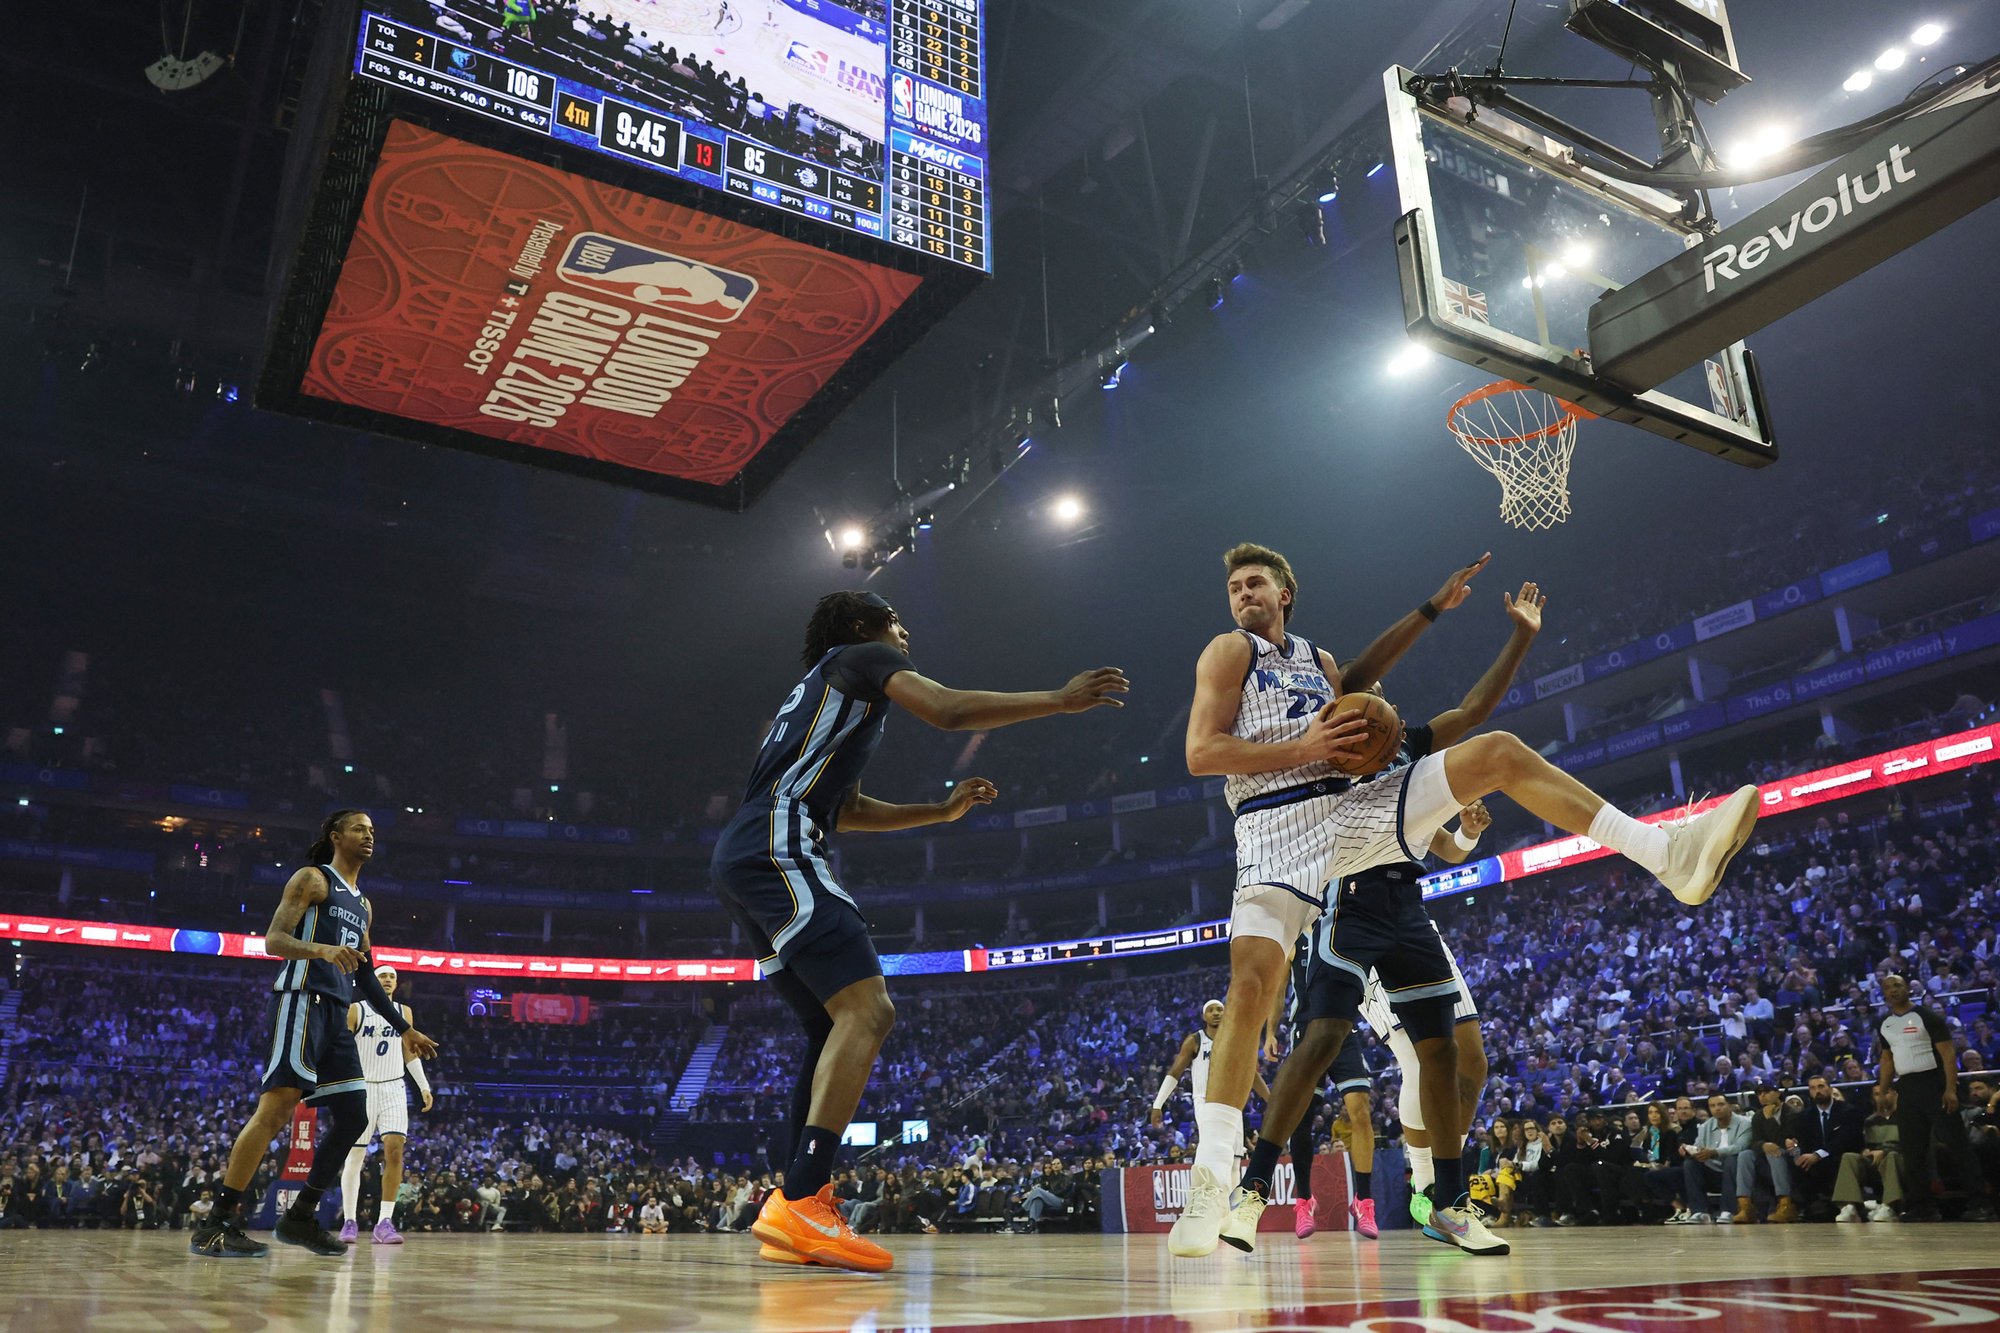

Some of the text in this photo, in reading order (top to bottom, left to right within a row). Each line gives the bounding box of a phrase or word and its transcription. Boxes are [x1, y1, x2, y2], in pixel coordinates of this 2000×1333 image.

[377, 24, 424, 47] TOL 4
[902, 14, 968, 49] 8 17 3
[930, 12, 938, 22] 9
[960, 25, 967, 35] 1
[375, 39, 422, 62] FLS 2
[897, 42, 969, 78] 23 13 2
[898, 28, 914, 41] 12
[926, 38, 942, 53] 22
[960, 52, 968, 64] 2
[507, 68, 539, 101] 106
[897, 56, 969, 91] 45 5 0
[368, 61, 546, 126] FG% 54.8 3PT% 40.0 FT% 66.7
[915, 81, 963, 118] LONDON
[564, 101, 590, 128] 4TH
[915, 101, 948, 131] GAME
[949, 114, 981, 143] 2026
[616, 112, 667, 158] 9:45
[696, 143, 713, 167] 13
[744, 146, 766, 175] 85
[908, 138, 965, 170] MAGIC
[836, 176, 874, 195] TOL 4
[901, 169, 971, 201] 0 15 3
[925, 163, 945, 177] PTS
[958, 175, 976, 188] FLS
[730, 178, 879, 231] FG% 43.6 3PT% 21.7 FT% 100.0
[836, 190, 874, 208] FLS 2
[901, 184, 972, 216] 3 8 3
[896, 214, 973, 248] 22 14 2
[901, 200, 972, 231] 5 11 0
[1703, 143, 1917, 293] Revolut
[509, 219, 563, 279] Presented by
[576, 240, 616, 270] NBA
[896, 230, 973, 263] 34 15 3
[464, 309, 518, 376] TISSOT
[479, 291, 632, 428] GAME 2026
[579, 312, 721, 418] LONDON
[1255, 669, 1329, 693] MAGIC
[1746, 695, 1770, 710] The
[1795, 681, 1808, 694] is
[1810, 666, 1853, 690] better
[1856, 655, 1893, 676] with
[1895, 636, 1958, 664] Priority
[1286, 690, 1326, 719] 22
[1608, 730, 1660, 751] exclusive
[1664, 719, 1691, 736] bars
[340, 926, 360, 949] 12
[376, 1040, 389, 1056] 0
